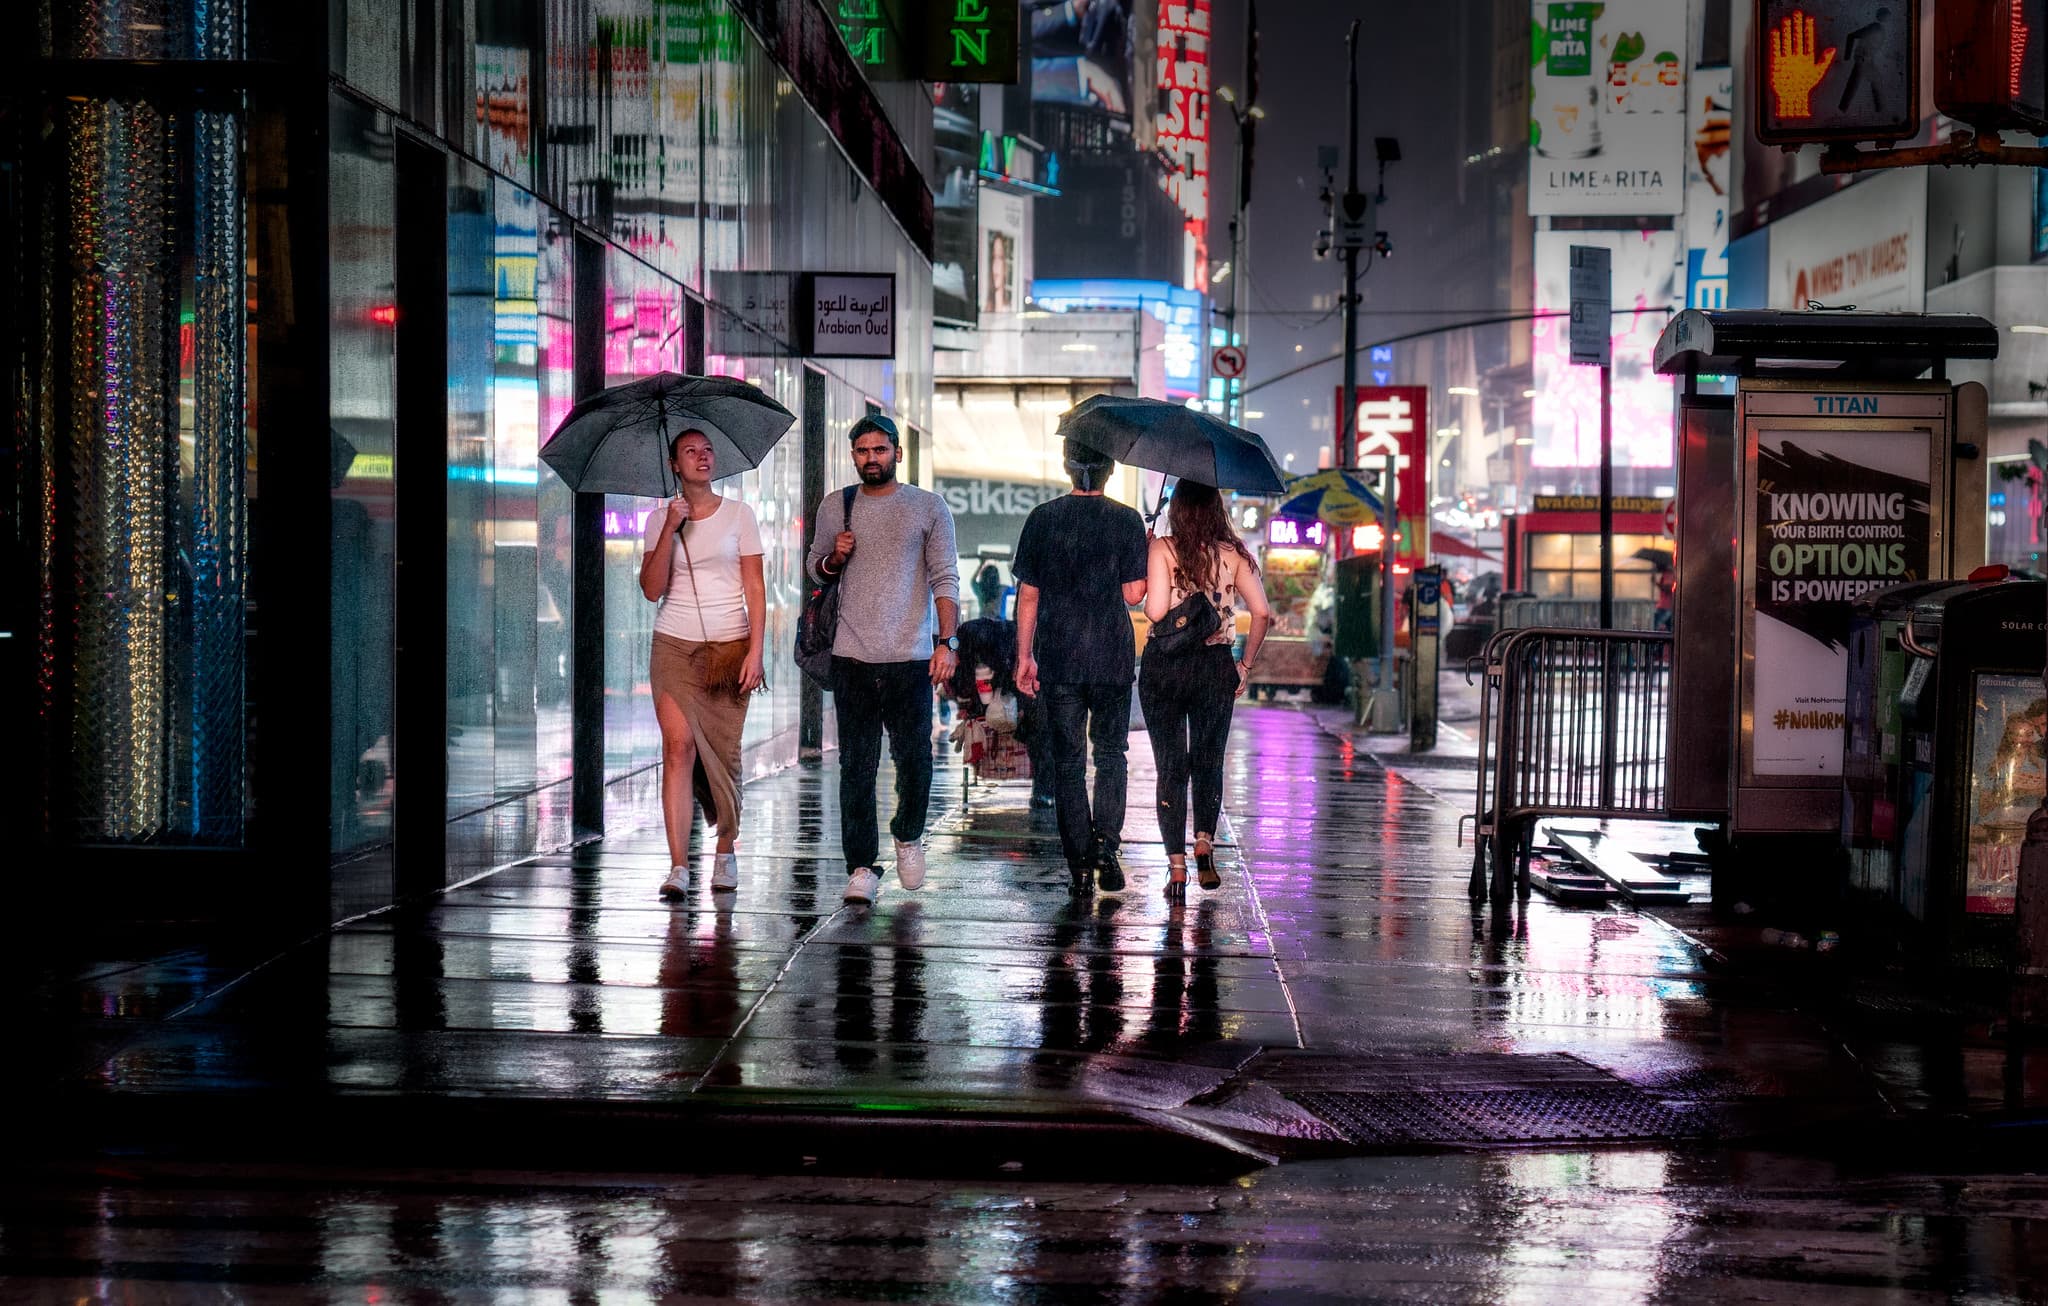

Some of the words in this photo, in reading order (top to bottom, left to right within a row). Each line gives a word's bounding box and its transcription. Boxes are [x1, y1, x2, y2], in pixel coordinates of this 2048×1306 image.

[1551, 18, 1587, 32] LIME
[1551, 40, 1586, 56] RITA
[1549, 170, 1598, 188] LIME
[1616, 170, 1663, 188] RITA
[817, 296, 847, 317] للعود
[849, 296, 889, 317] العربية
[817, 319, 862, 335] Arabian
[865, 318, 889, 335] Oud
[1813, 396, 1878, 414] TITAN
[1536, 496, 1595, 511] wafels
[1612, 496, 1664, 513] dinge
[1771, 492, 1905, 521] KNOWING
[1771, 525, 1806, 539] YOUR
[1808, 525, 1845, 539] BIRTH
[1847, 525, 1905, 539] CONTROL
[1769, 543, 1906, 576] OPTIONS
[1771, 579, 1790, 601] IS
[2001, 621, 2033, 630] SOLAR
